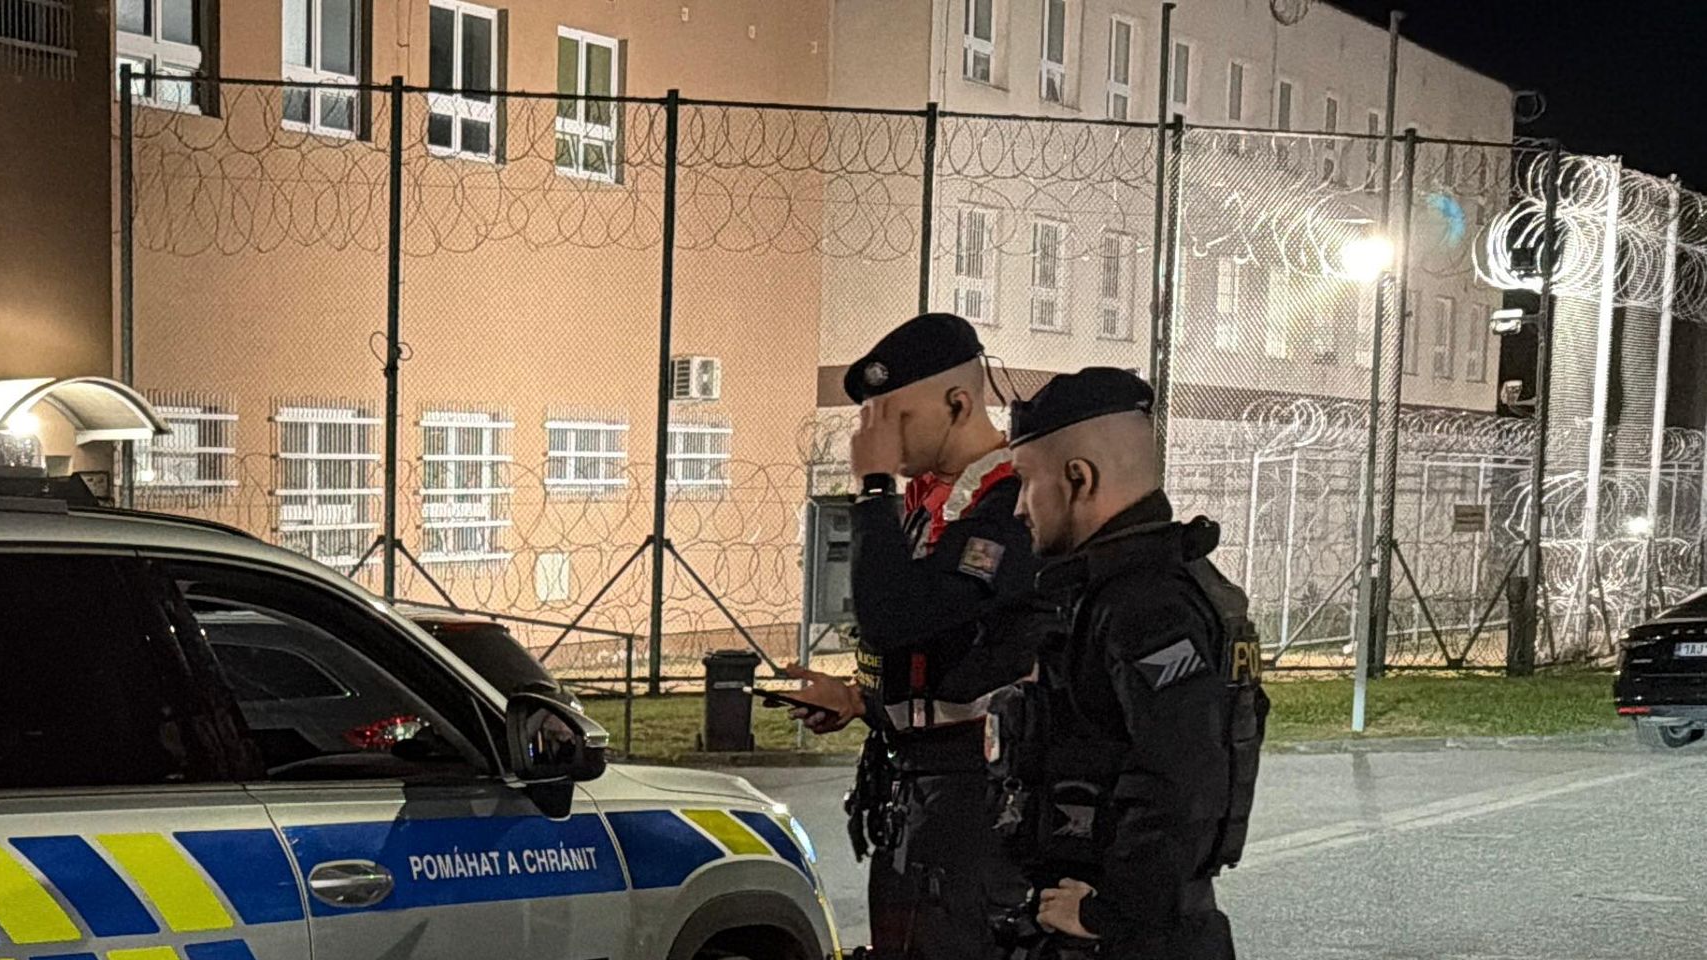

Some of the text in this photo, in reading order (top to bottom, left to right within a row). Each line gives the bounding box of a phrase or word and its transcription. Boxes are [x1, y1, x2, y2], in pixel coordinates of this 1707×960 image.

[1684, 643, 1707, 656] 1AJ
[408, 841, 598, 881] POMÁHAT A CHRÁNIT
